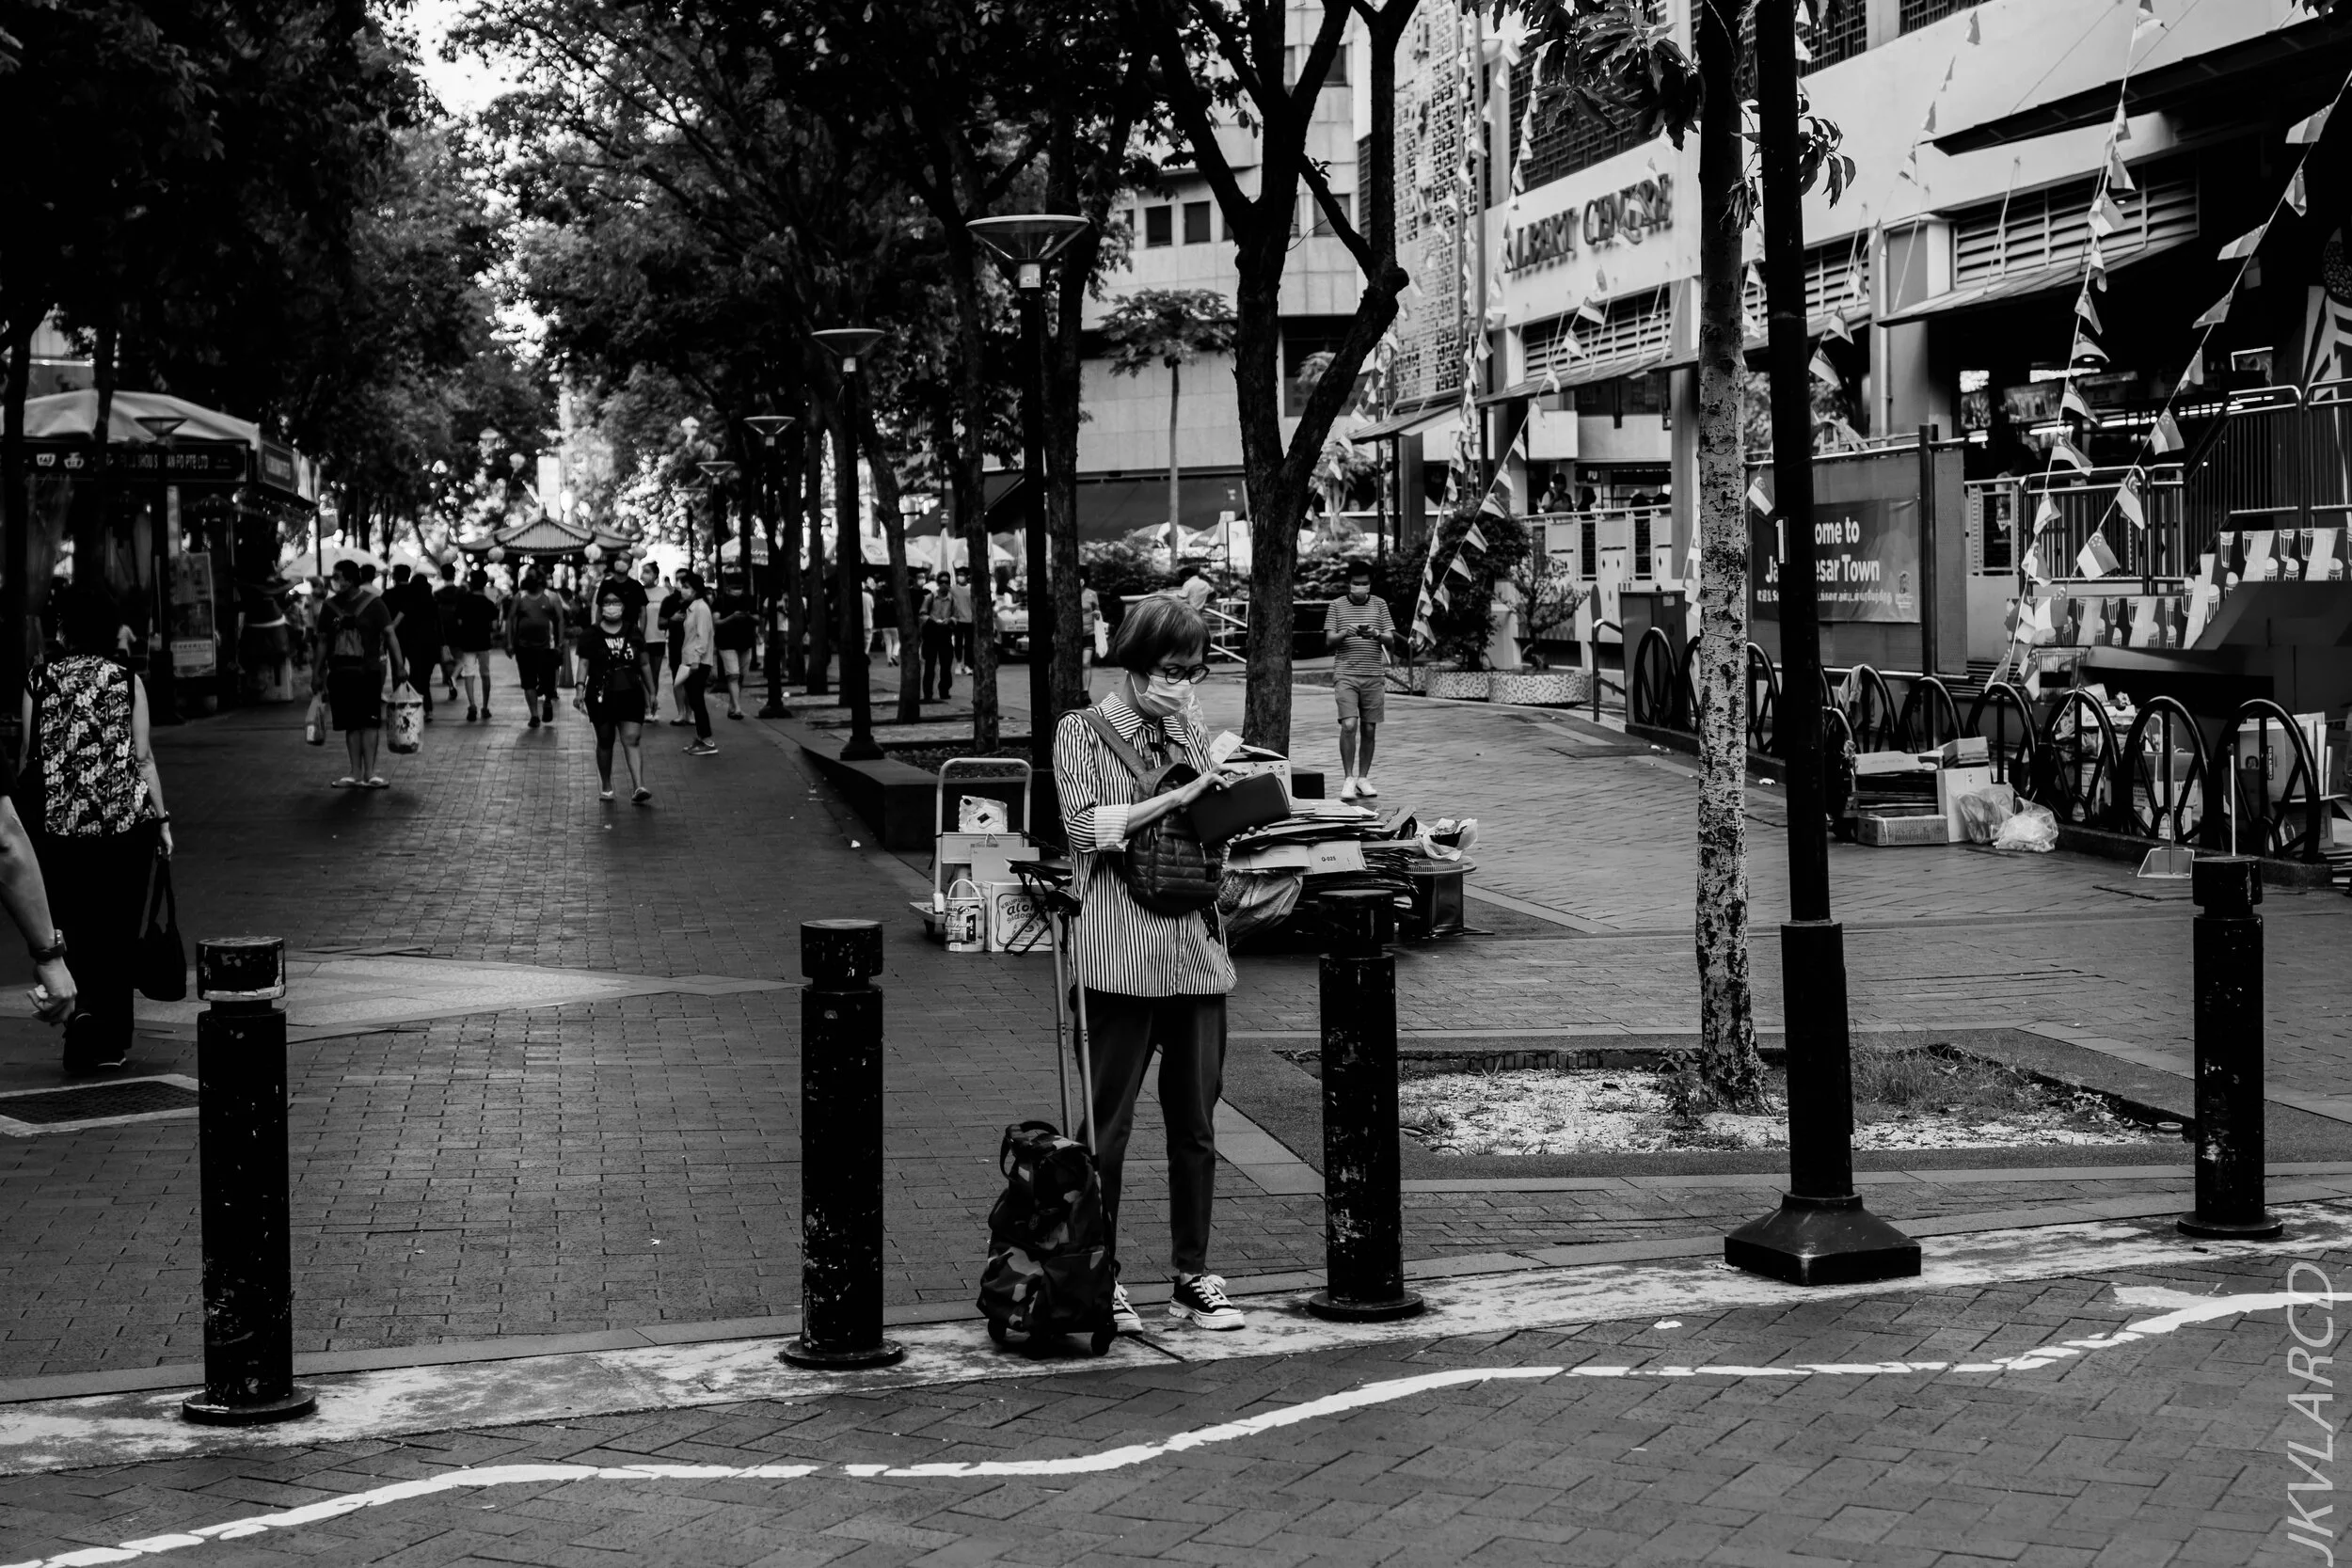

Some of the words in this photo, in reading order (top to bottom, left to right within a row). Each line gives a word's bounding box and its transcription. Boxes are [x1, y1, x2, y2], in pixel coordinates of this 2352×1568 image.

[1582, 172, 1672, 246] CENTRE
[184, 453, 197, 470] PTE
[198, 453, 209, 470] LTD
[1845, 516, 1860, 544] to
[1841, 554, 1881, 582] Town
